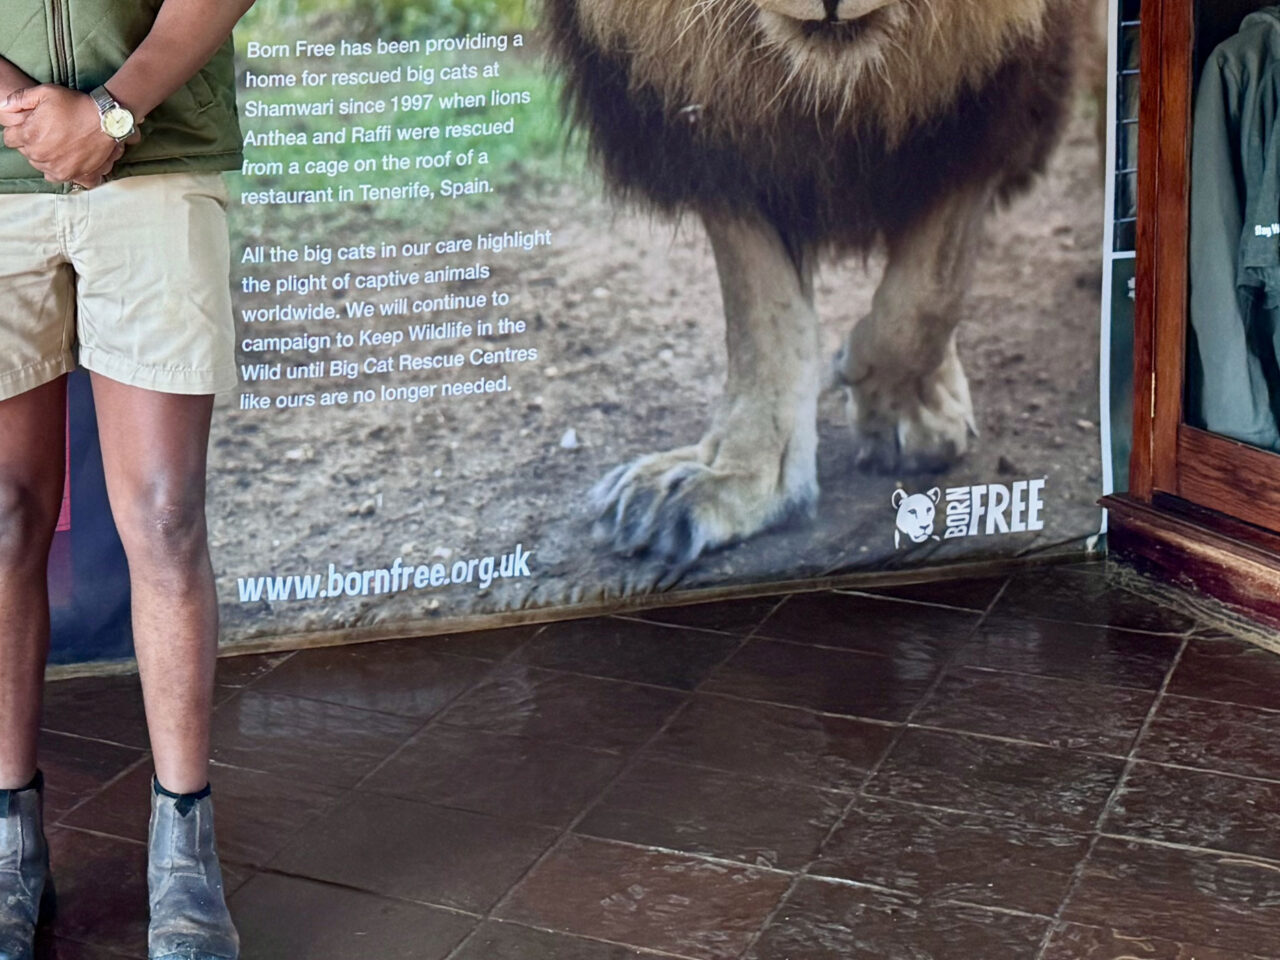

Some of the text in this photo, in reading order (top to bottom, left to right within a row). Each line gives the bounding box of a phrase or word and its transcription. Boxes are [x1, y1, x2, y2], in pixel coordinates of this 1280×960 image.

[247, 32, 523, 58] Born Free has been providing a
[245, 61, 499, 88] home for rescued big cats at
[244, 89, 531, 117] Shamwari since 1997 when lions
[243, 117, 514, 148] Anthea and Raffi were rescued
[242, 148, 488, 177] from a cage on the roof of a
[241, 177, 494, 205] restaurant in Tenerife, Spain.
[241, 229, 551, 265] All the big cats in our care highlight
[241, 262, 490, 296] the plight of captive animals
[241, 290, 509, 323] worldwide. We will continue to
[241, 317, 526, 355] campaign to Keep Wildlife in the
[241, 343, 537, 381] Wild until Big Cat Rescue Centres
[239, 375, 511, 410] like ours are no longer needed.
[944, 479, 1045, 539] BORN FREE
[237, 544, 531, 602] www.bornfree.org.uk
